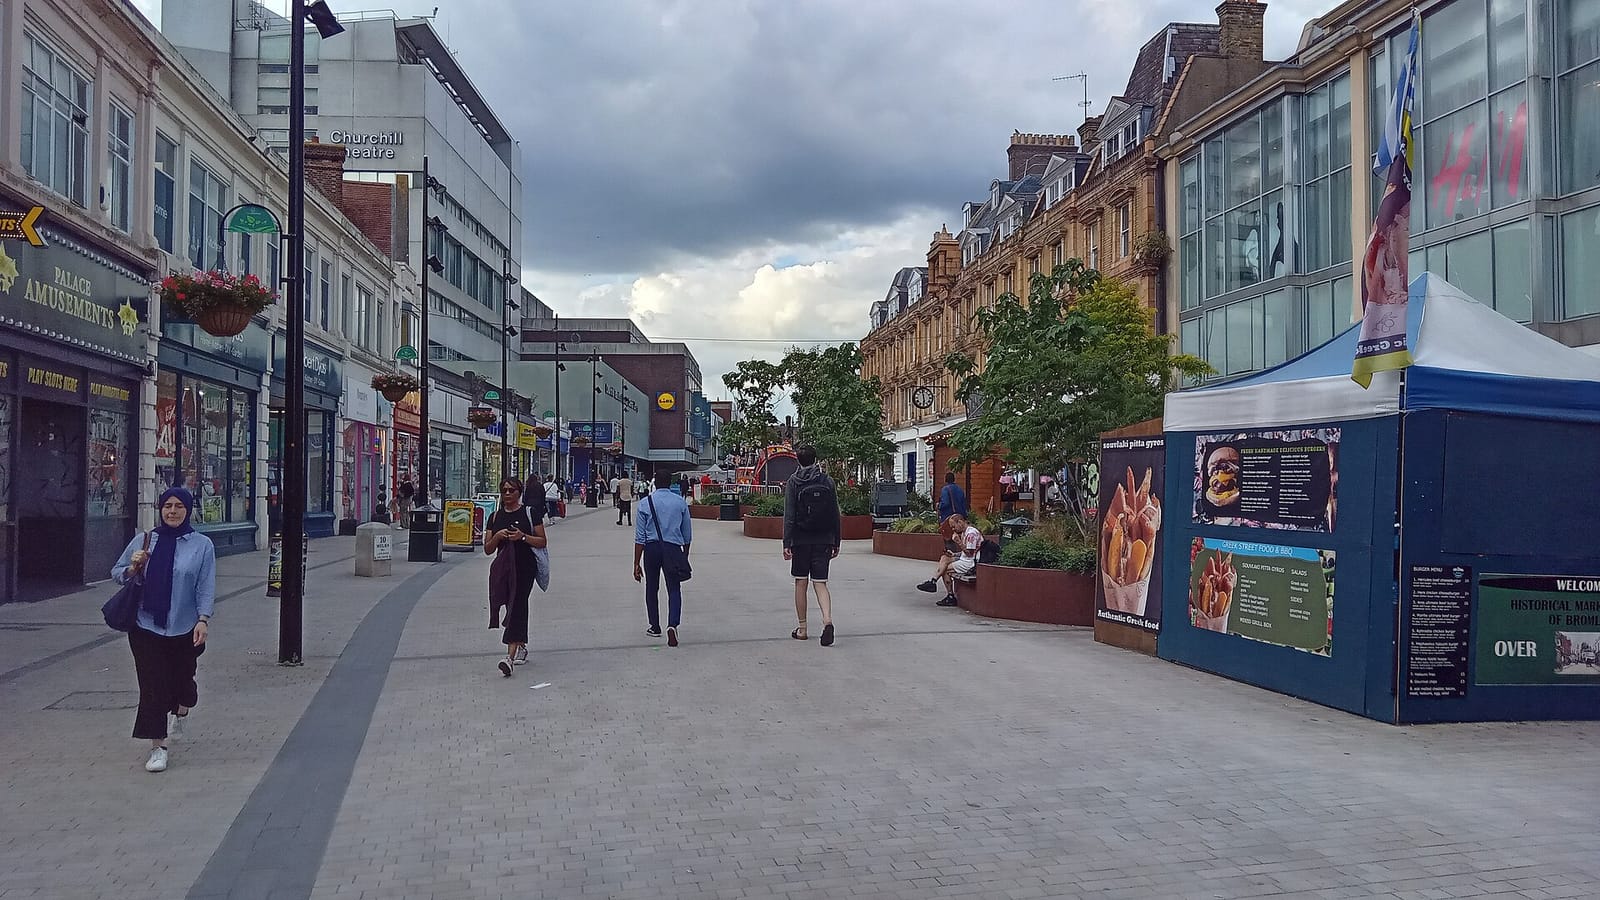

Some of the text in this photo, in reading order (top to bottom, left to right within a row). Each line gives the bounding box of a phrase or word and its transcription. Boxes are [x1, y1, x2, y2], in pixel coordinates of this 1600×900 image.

[330, 130, 403, 145] Churchill
[344, 146, 394, 158] heatre
[55, 266, 91, 297] PALACE
[24, 278, 114, 330] AMUSEMENTS
[28, 367, 45, 385] PLAY
[45, 371, 63, 390] SLOTS
[1103, 440, 1164, 449] souvlaki pitta gyros
[1238, 542, 1258, 551] STREET
[1258, 544, 1274, 553] FOOD
[1280, 546, 1293, 557] BBQ
[1510, 599, 1572, 611] HISTORICAL
[1097, 609, 1160, 630] Authentic Greek food
[1549, 614, 1561, 626] OF
[1494, 640, 1537, 657] OVER
